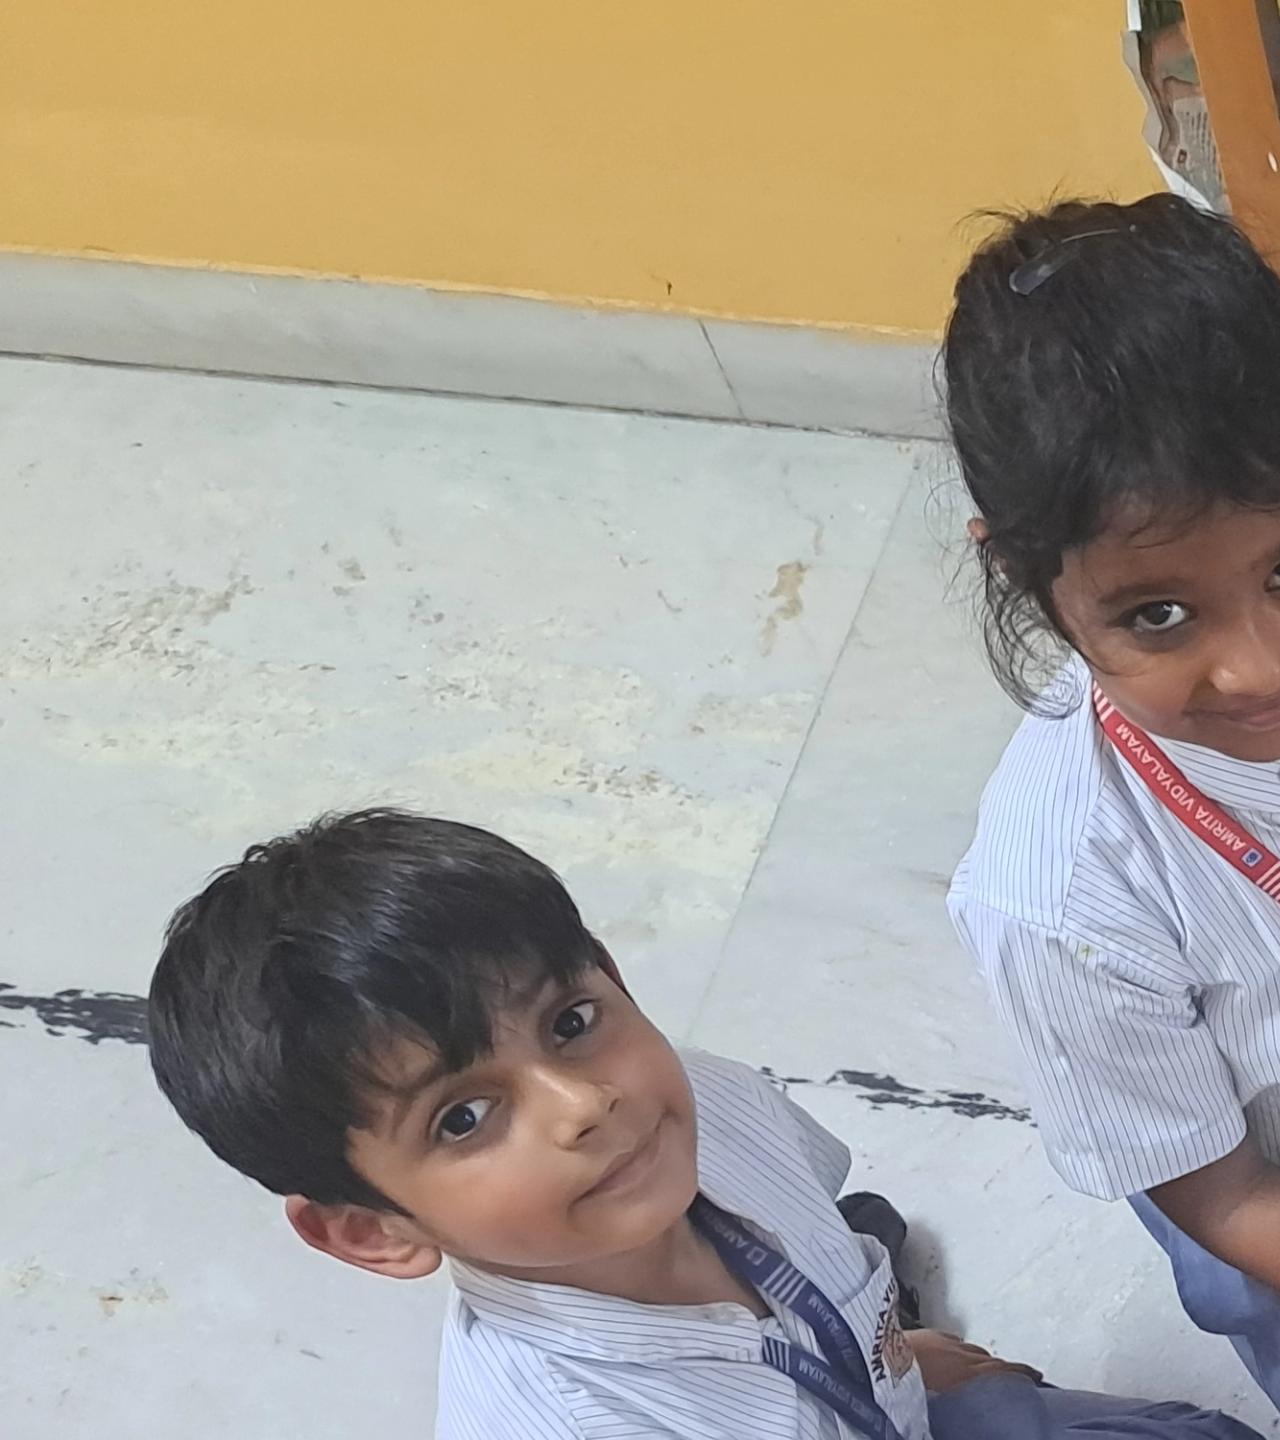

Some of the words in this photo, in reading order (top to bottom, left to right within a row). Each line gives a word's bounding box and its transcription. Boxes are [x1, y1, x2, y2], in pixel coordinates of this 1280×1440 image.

[1115, 723, 1195, 812] VIDYALAYAM
[1195, 805, 1246, 852] AMRITA
[871, 1307, 890, 1384] AMRITA
